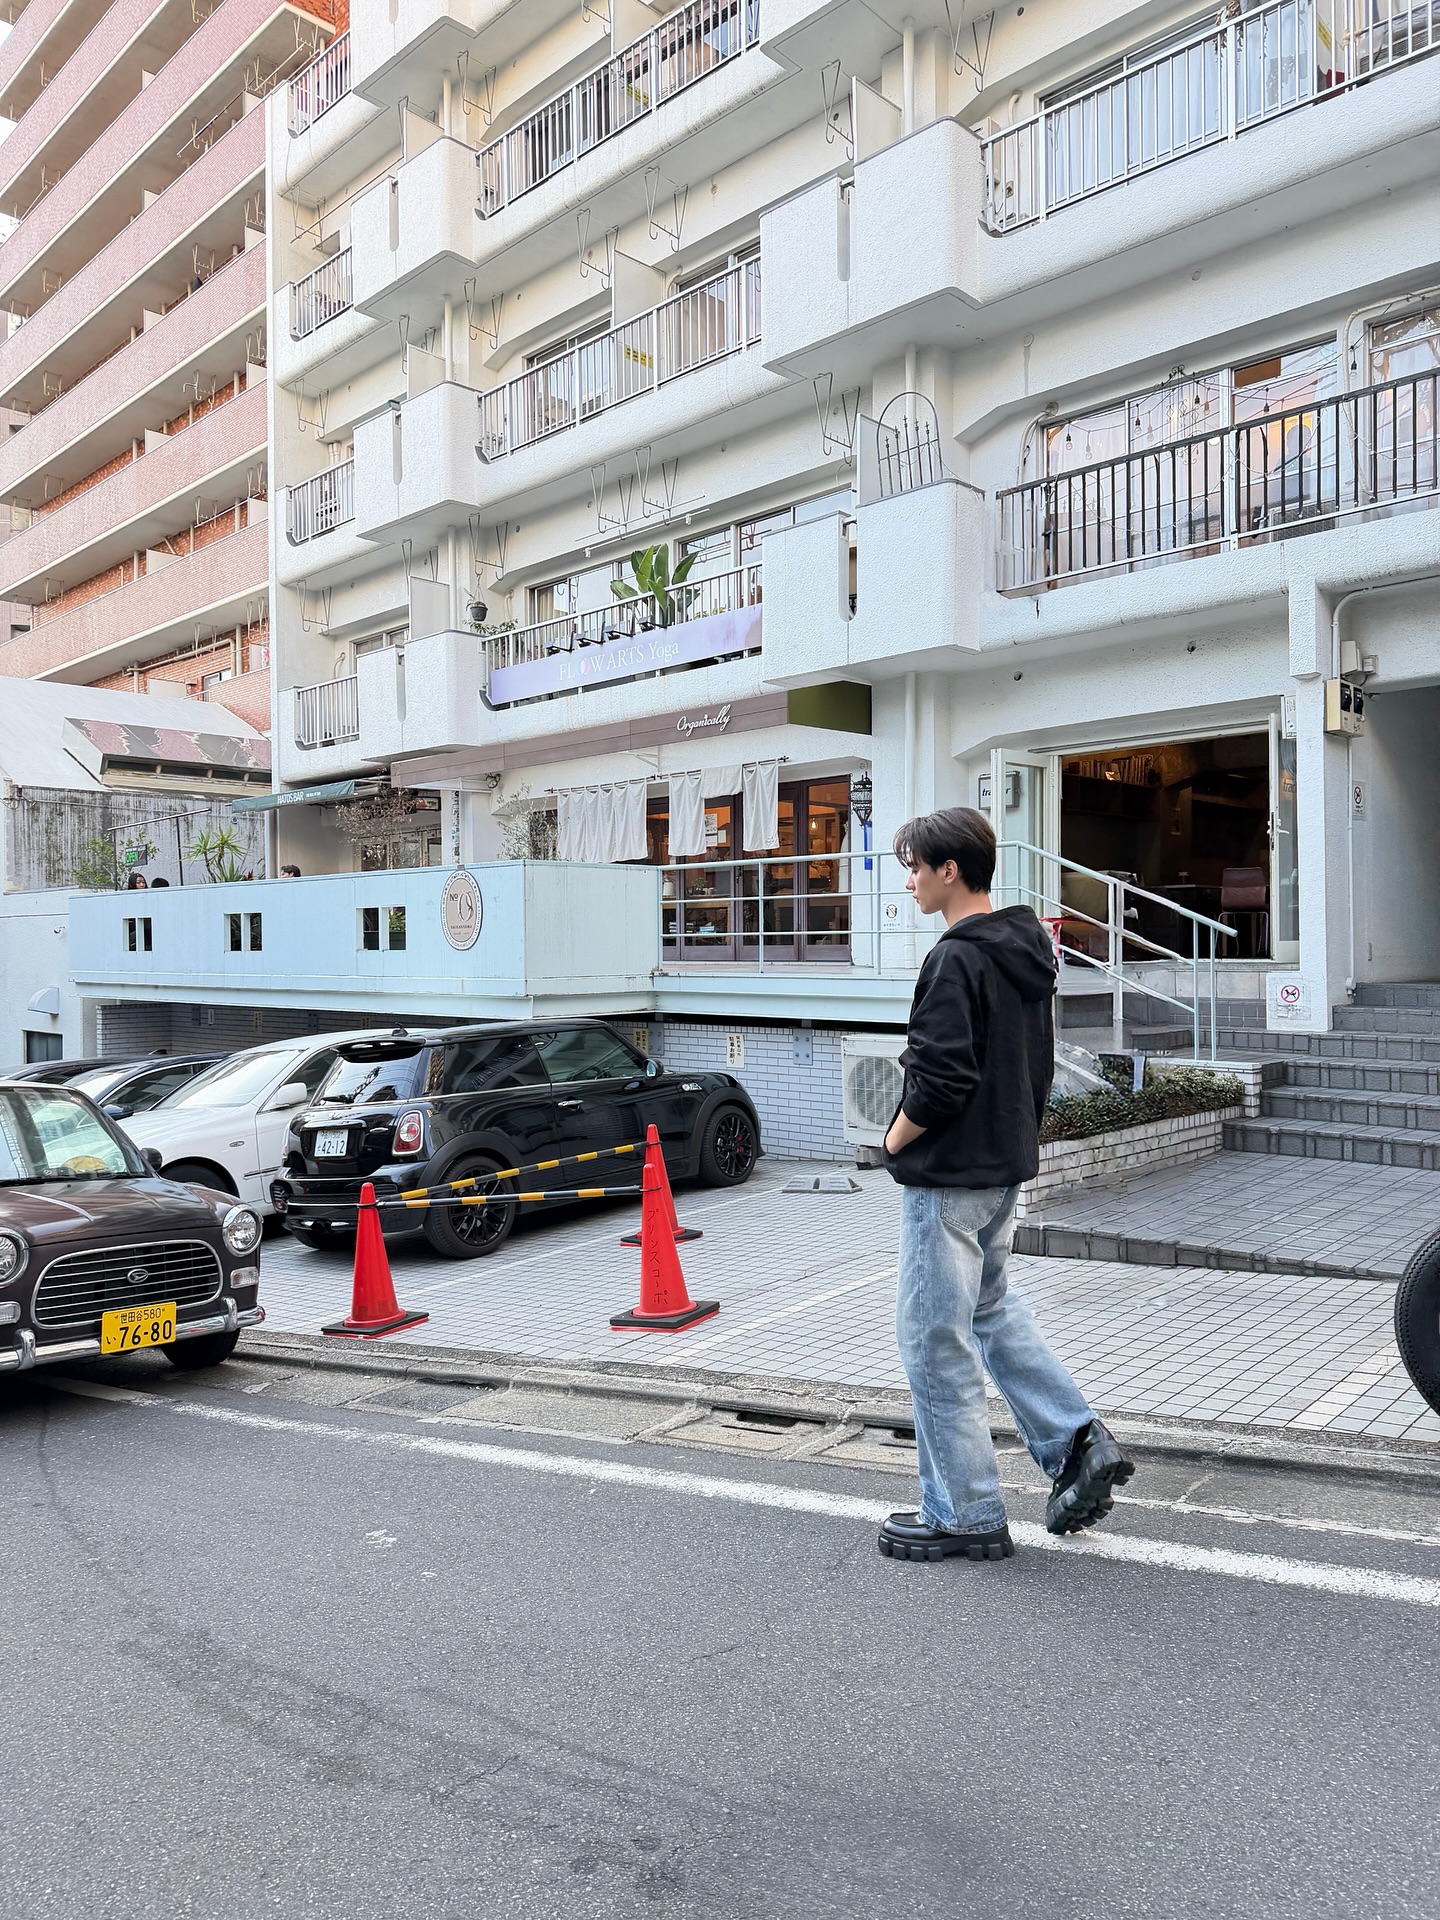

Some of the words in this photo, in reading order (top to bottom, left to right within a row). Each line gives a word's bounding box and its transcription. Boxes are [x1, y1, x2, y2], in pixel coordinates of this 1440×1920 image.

[606, 645, 645, 671] ARTS
[648, 641, 680, 663] Yoga
[676, 703, 731, 737] Organically
[294, 791, 305, 802] BAR
[322, 1140, 345, 1154] 42-12
[106, 1335, 116, 1345] い
[119, 1319, 172, 1348] 76-80
